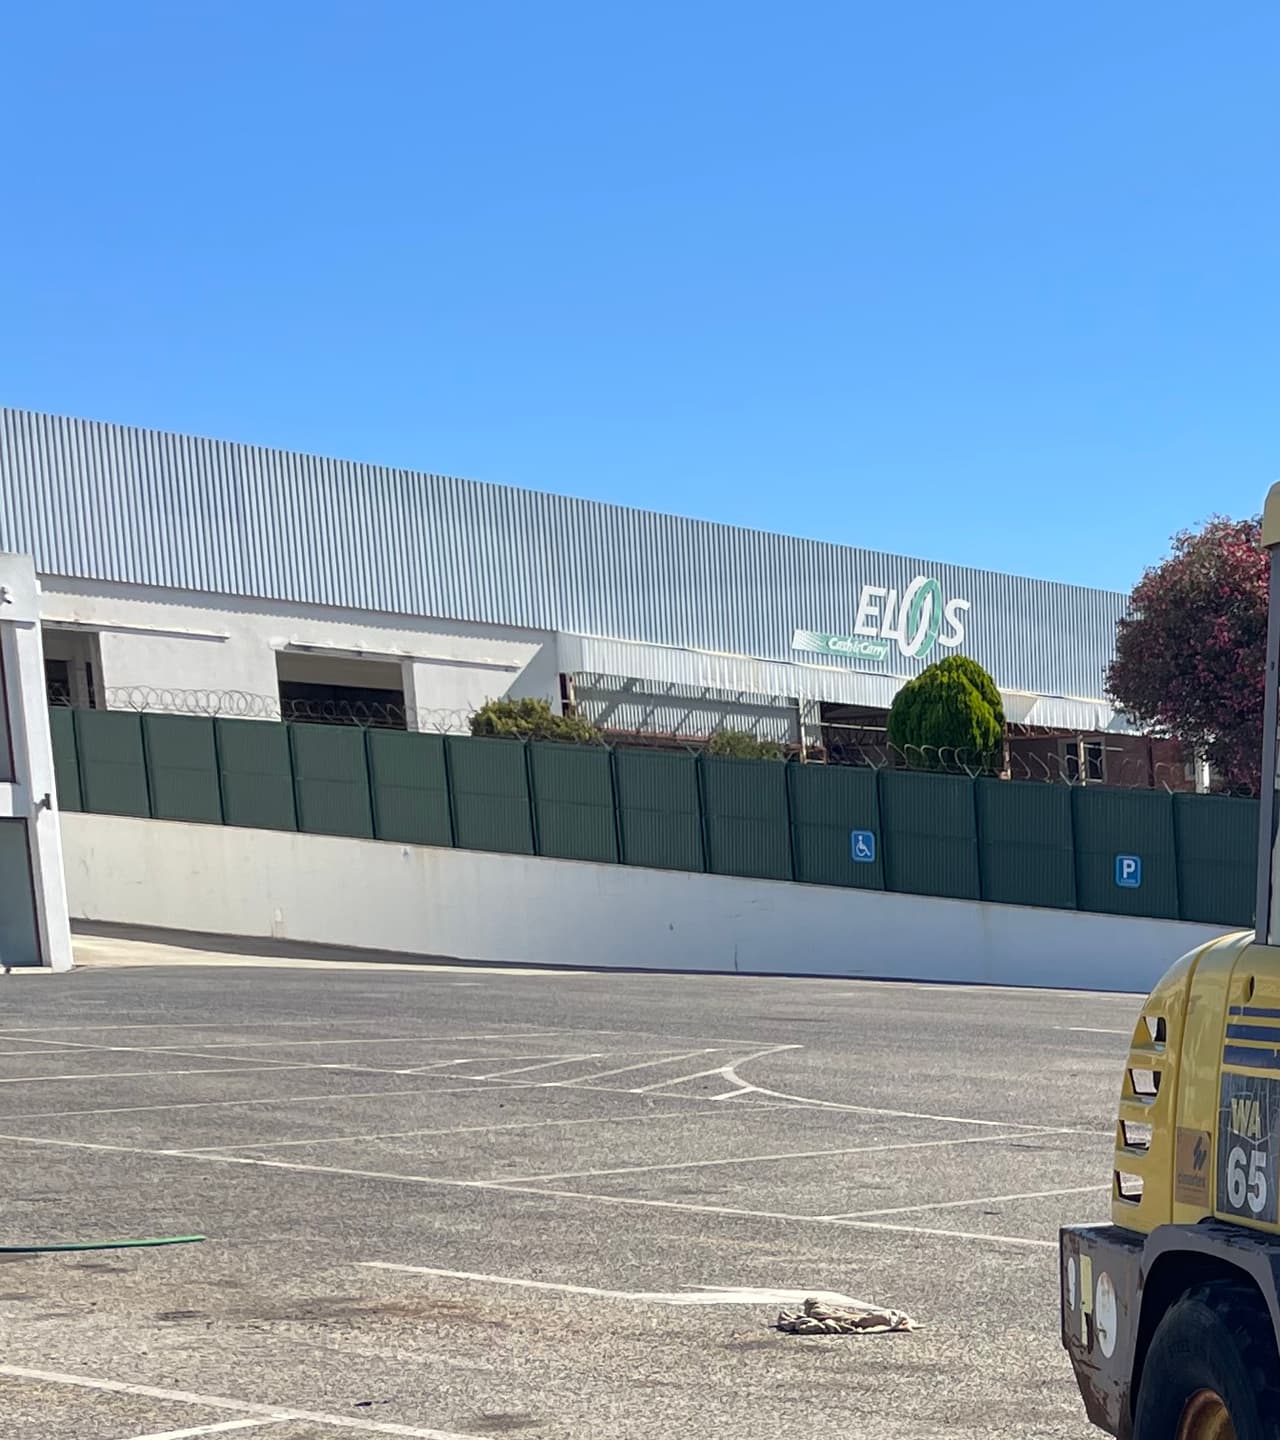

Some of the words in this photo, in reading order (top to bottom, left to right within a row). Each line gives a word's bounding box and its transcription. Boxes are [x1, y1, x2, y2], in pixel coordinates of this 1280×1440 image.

[853, 575, 971, 660] ELOS
[1122, 859, 1136, 879] P
[1231, 1098, 1262, 1138] WA
[1227, 1146, 1267, 1213] 65
